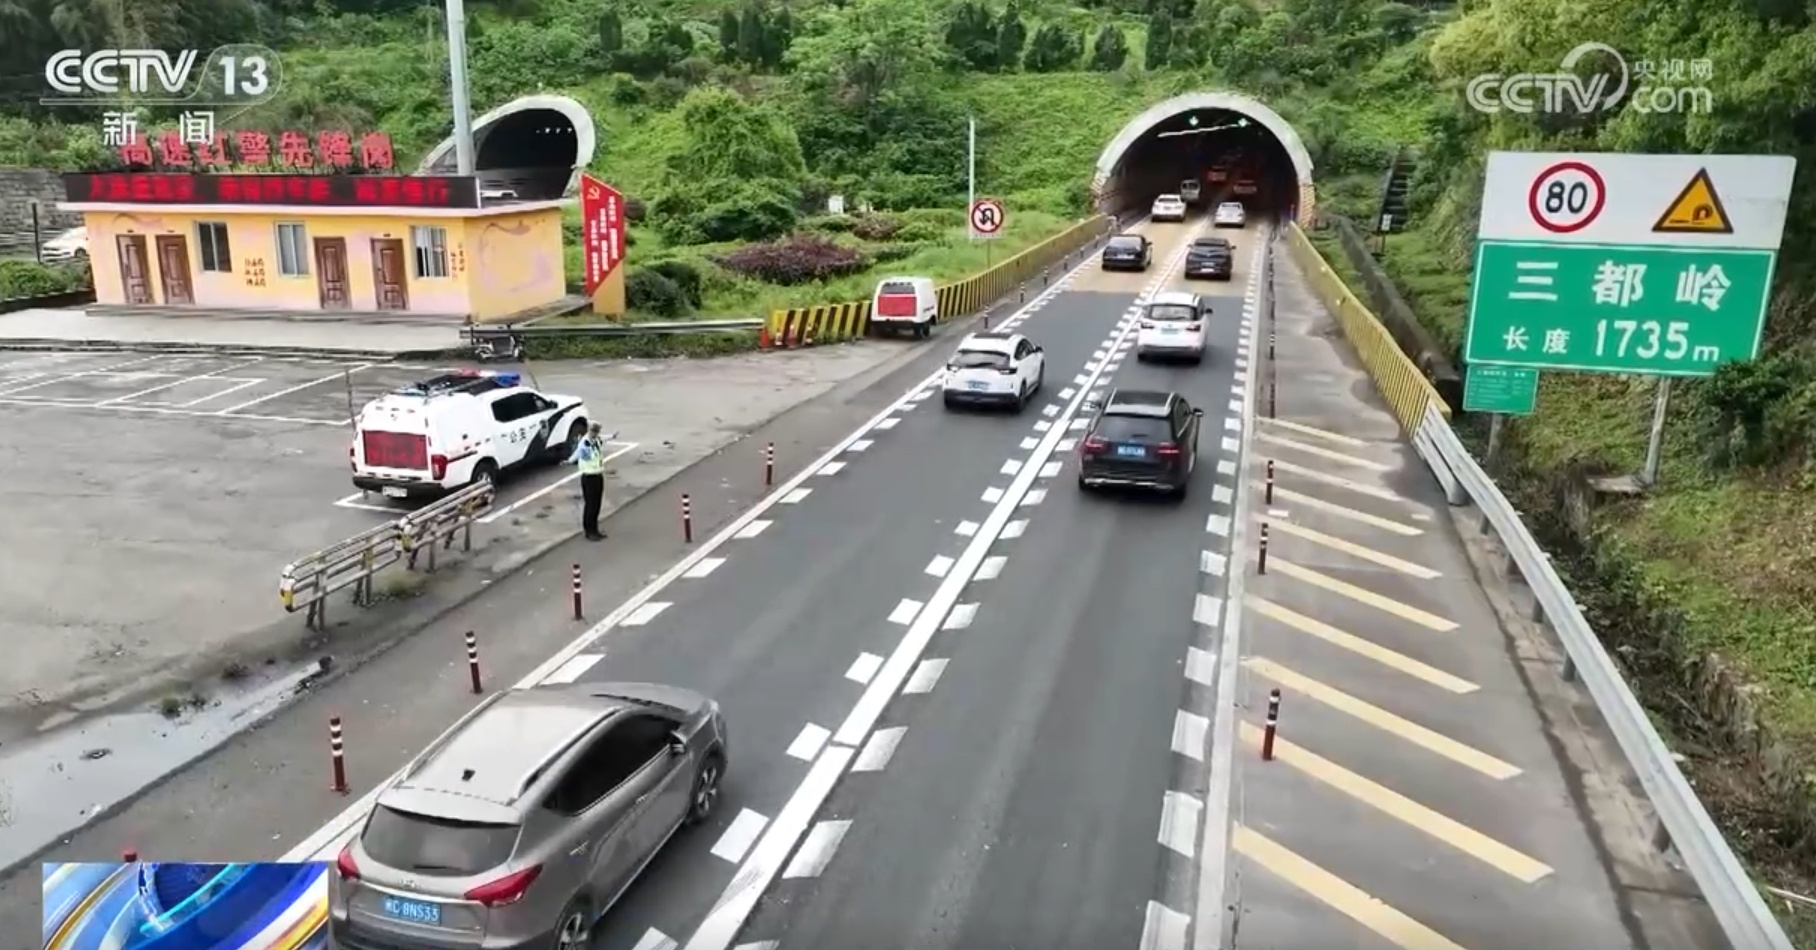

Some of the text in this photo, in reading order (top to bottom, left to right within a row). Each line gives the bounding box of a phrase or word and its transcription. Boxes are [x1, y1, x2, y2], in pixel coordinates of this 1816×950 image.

[1545, 181, 1588, 214] 80
[1508, 260, 1731, 311] 三都岭
[1503, 326, 1570, 354] 长度
